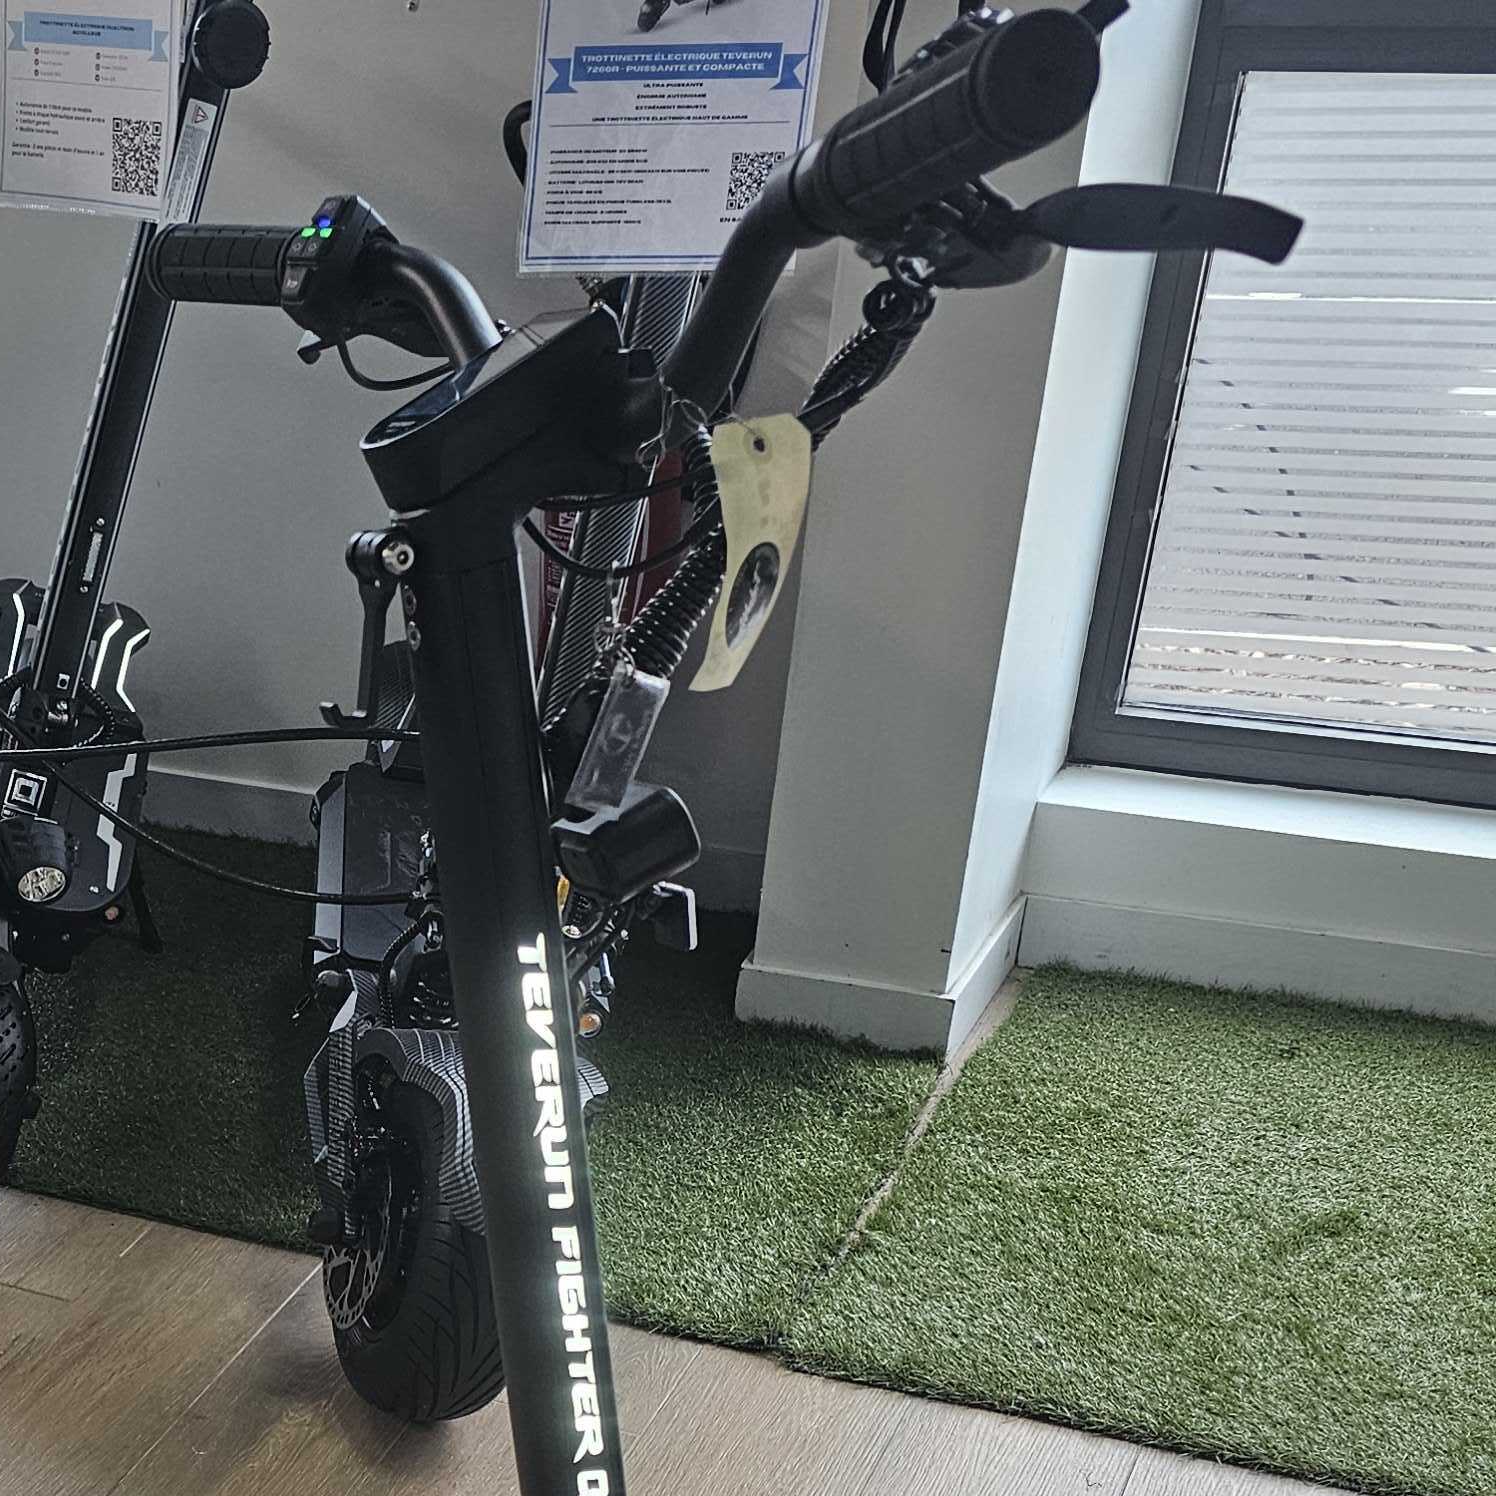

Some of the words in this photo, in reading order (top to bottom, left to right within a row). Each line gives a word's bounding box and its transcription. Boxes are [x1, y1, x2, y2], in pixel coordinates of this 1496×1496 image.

[582, 53, 652, 62] TROTTINETTE
[654, 51, 720, 61] ÉLECTRIQUE
[722, 51, 772, 60] TEVERUN
[626, 64, 686, 73] PUISSANTE
[703, 62, 764, 71] COMPACTE
[517, 932, 575, 1211] TEVERUN
[551, 1225, 605, 1463] FIGHTER
